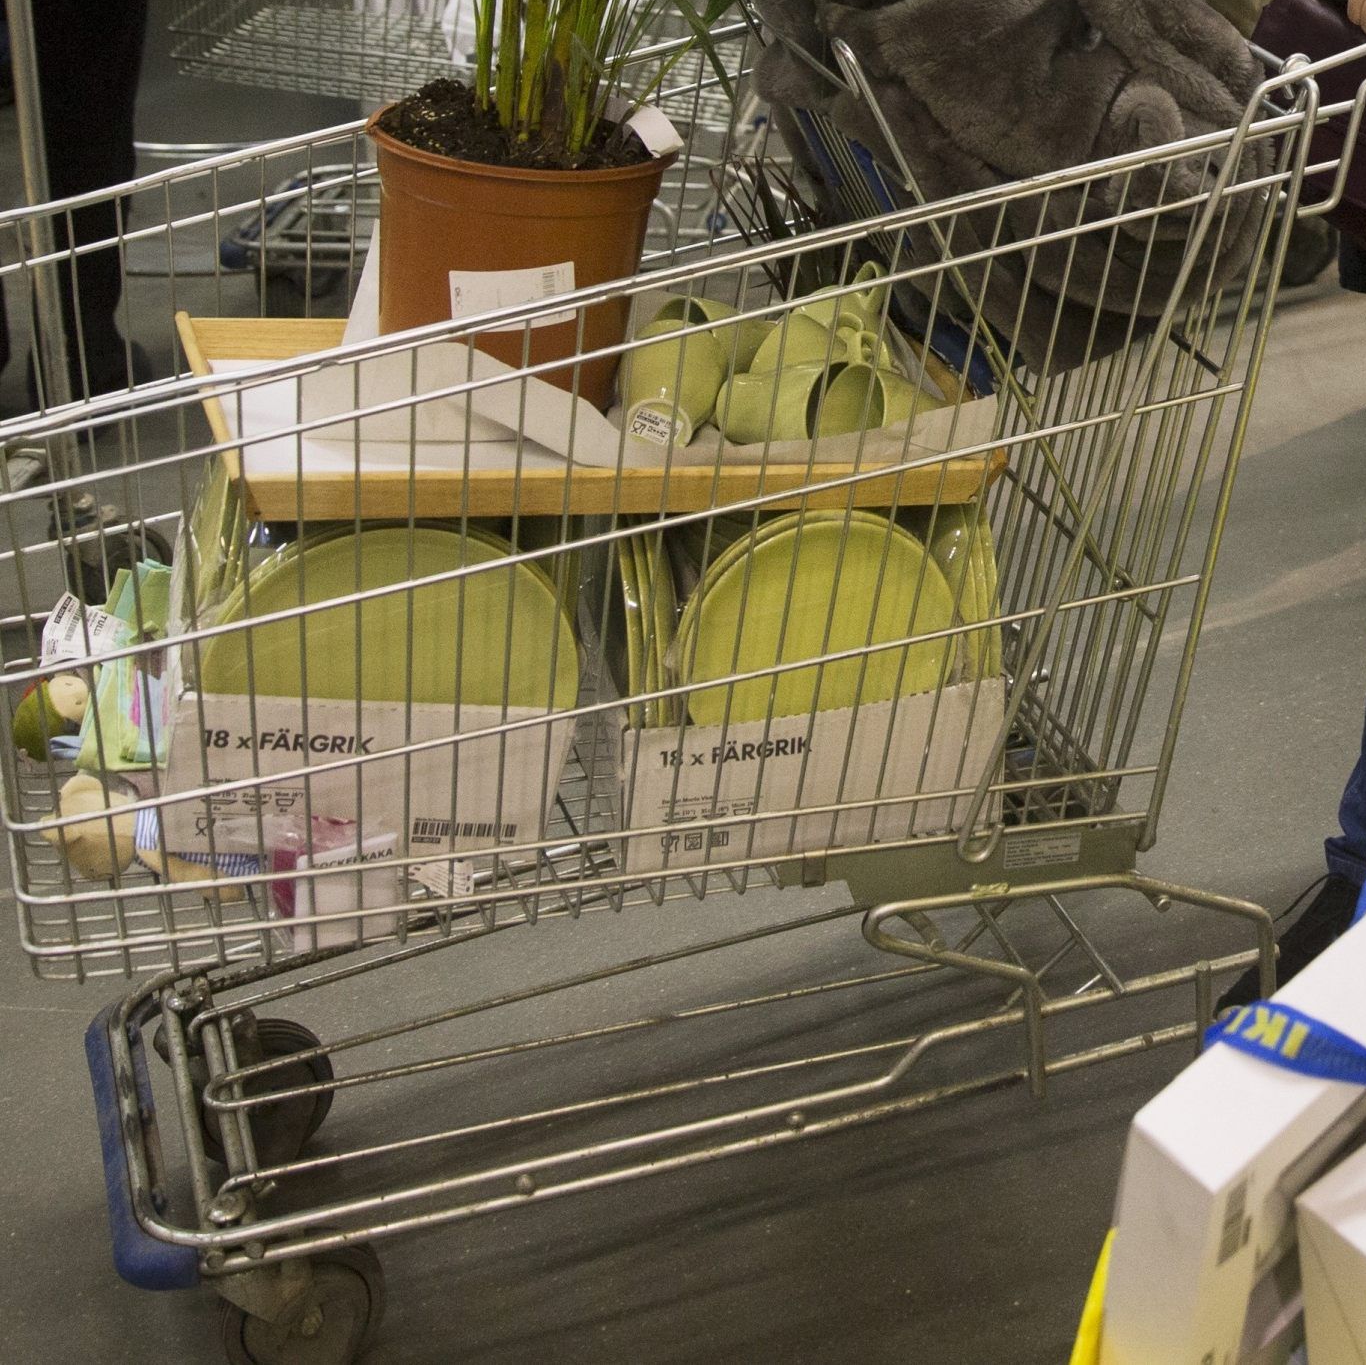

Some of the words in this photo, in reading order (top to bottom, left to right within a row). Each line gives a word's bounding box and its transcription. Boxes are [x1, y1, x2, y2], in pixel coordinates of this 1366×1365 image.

[204, 729, 230, 749] 18
[236, 736, 252, 750] x
[659, 749, 684, 768] 18
[690, 751, 705, 766] x
[711, 736, 813, 764] FÄRGRIK
